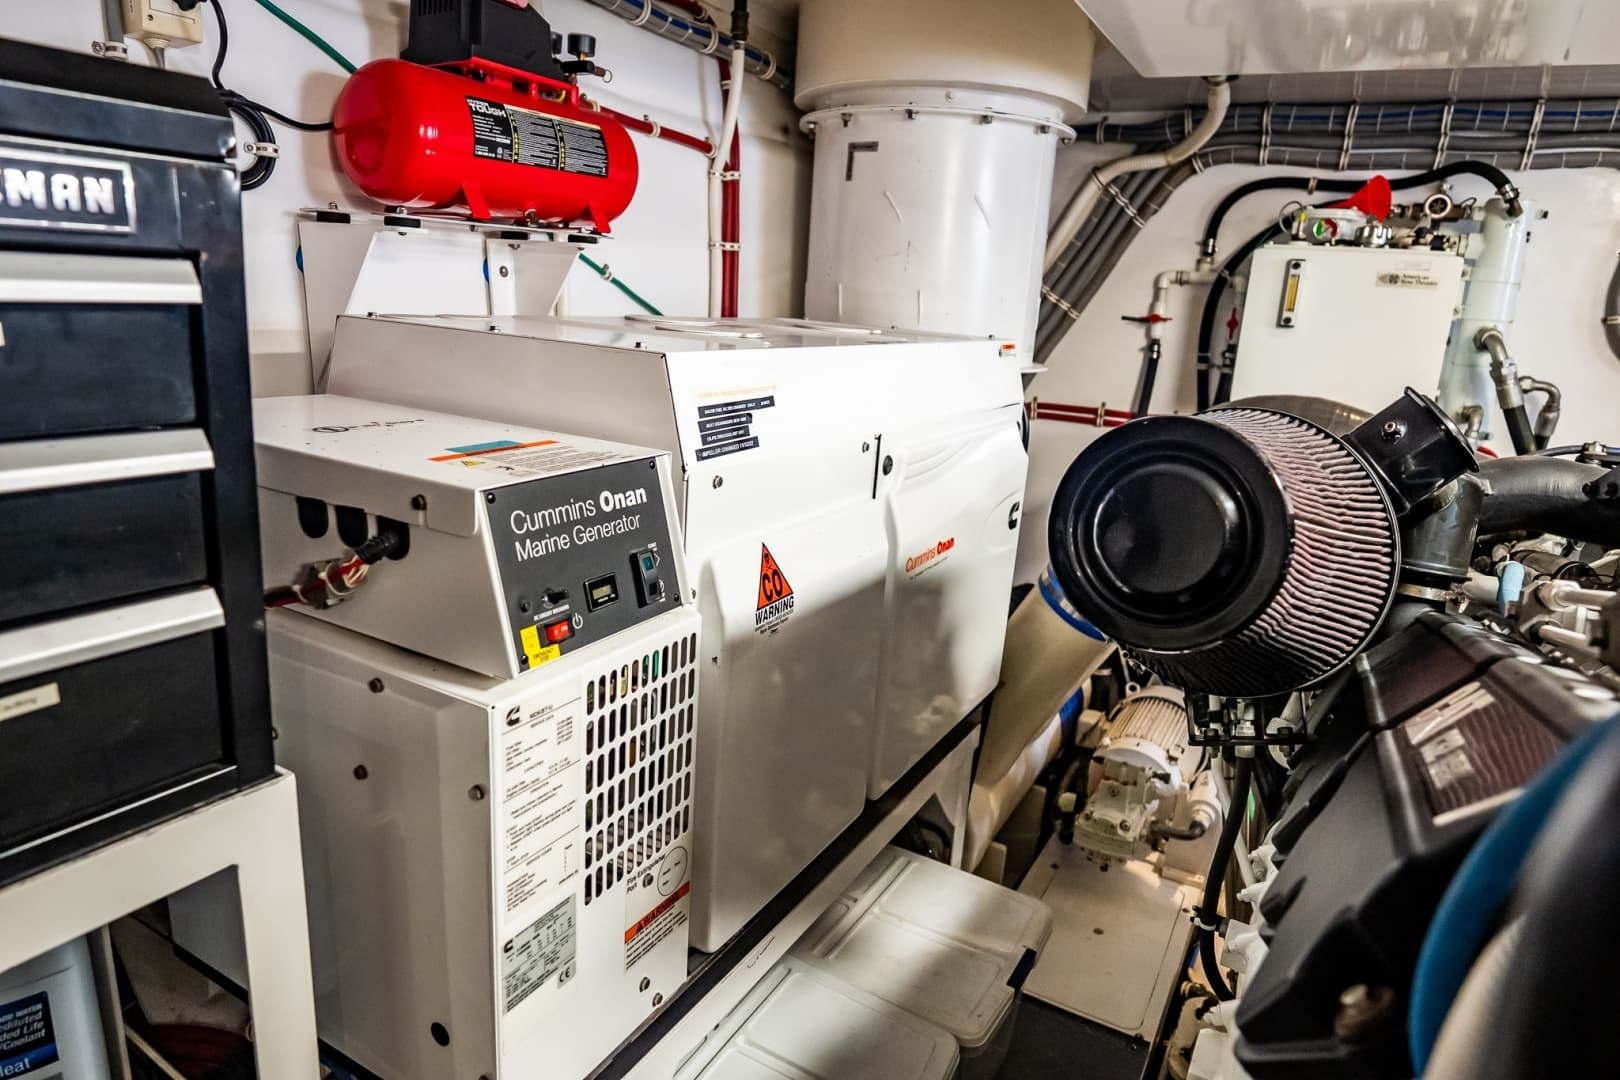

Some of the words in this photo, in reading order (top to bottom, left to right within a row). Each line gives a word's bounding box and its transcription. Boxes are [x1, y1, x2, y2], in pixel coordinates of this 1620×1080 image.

[470, 102, 507, 118] TOUGH
[0, 167, 115, 215] MAN
[510, 497, 597, 535] Cummins
[599, 487, 648, 513] Onan
[514, 536, 571, 563] Marine
[572, 513, 641, 546] Generator
[905, 547, 936, 573] Cummins
[937, 537, 955, 555] Onan
[761, 569, 784, 602] CO
[755, 595, 794, 626] WARNING
[626, 875, 637, 887] Fire
[637, 853, 667, 878] Extinguisher
[626, 883, 638, 894] Port
[641, 889, 681, 924] WARNING
[23, 1021, 44, 1034] Life
